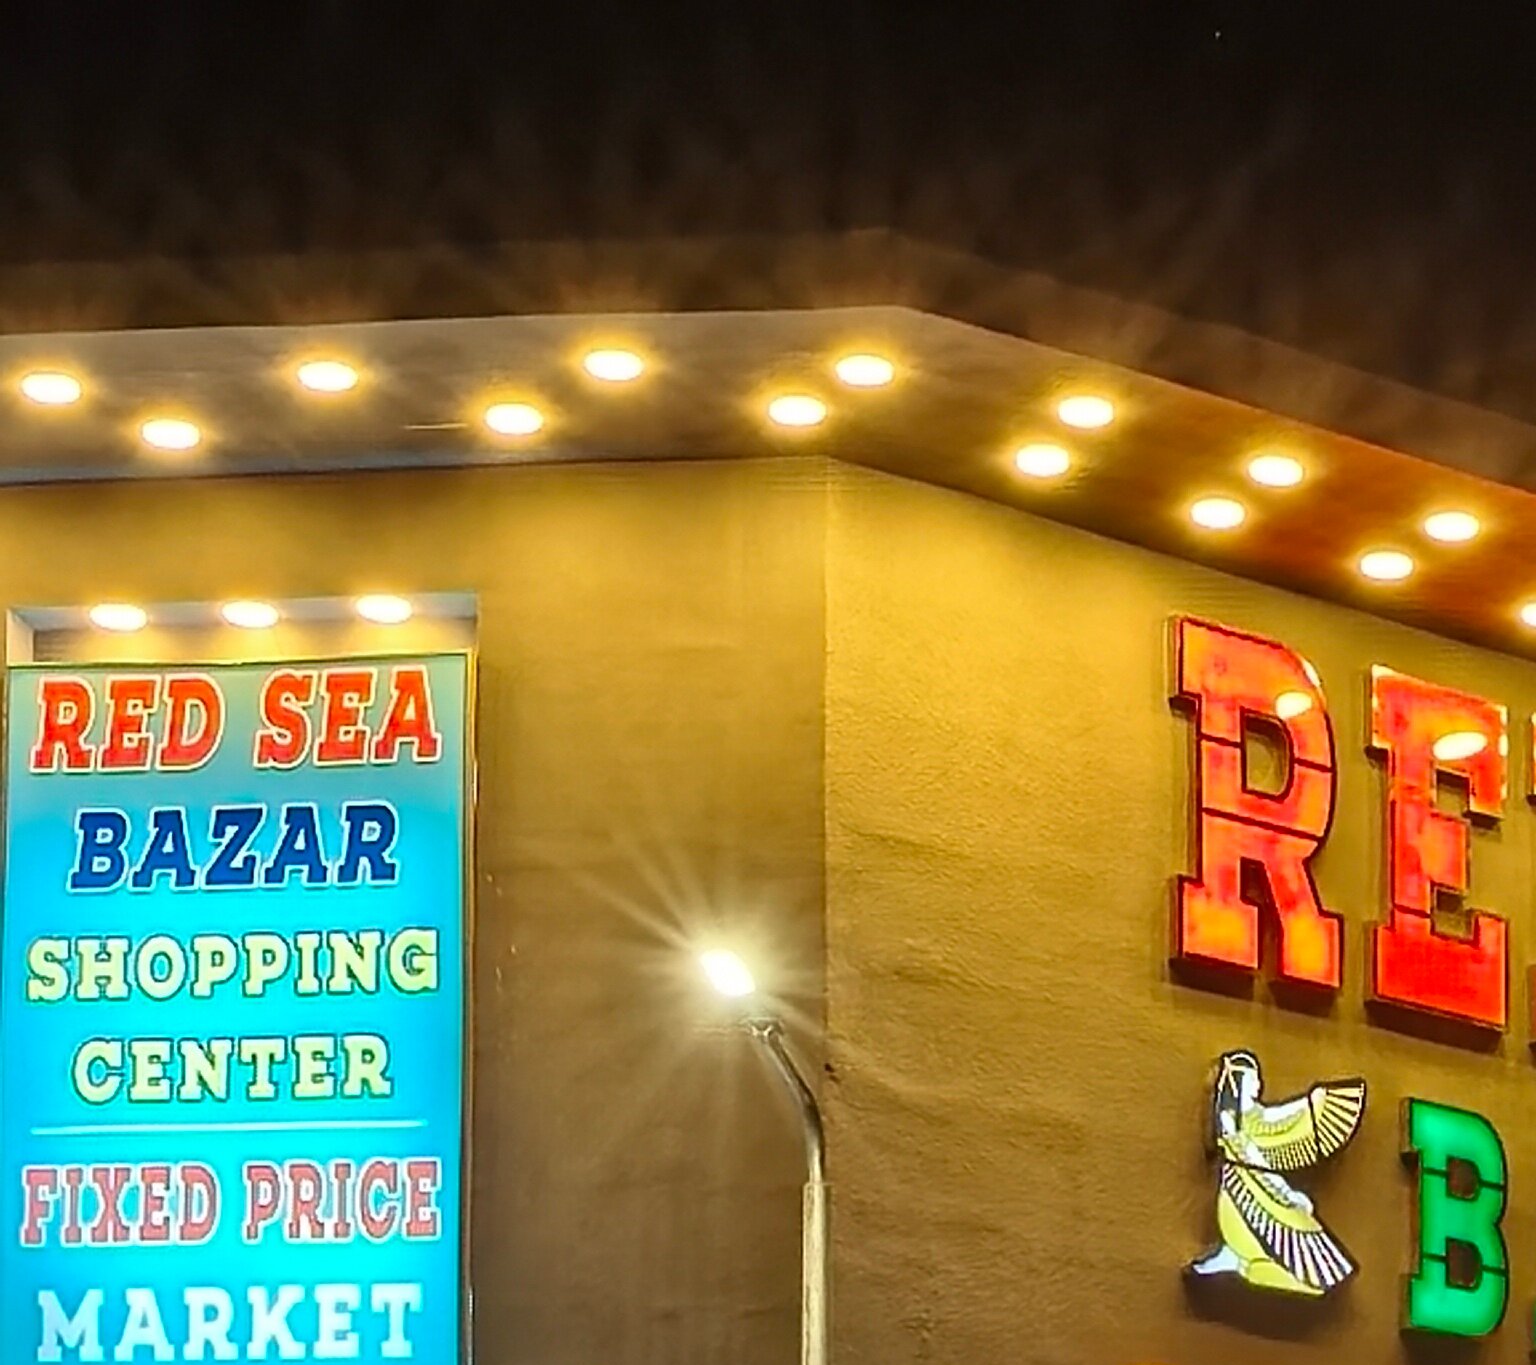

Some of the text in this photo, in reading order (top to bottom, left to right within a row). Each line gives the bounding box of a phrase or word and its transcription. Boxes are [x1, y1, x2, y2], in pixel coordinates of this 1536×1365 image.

[29, 663, 442, 774] RED SEA
[67, 802, 400, 893] BAZAR
[26, 928, 440, 1003] SHOPPING
[72, 1034, 394, 1105] CENTER
[20, 1156, 443, 1248] FIXED PRICE
[36, 1282, 424, 1364] MARKET
